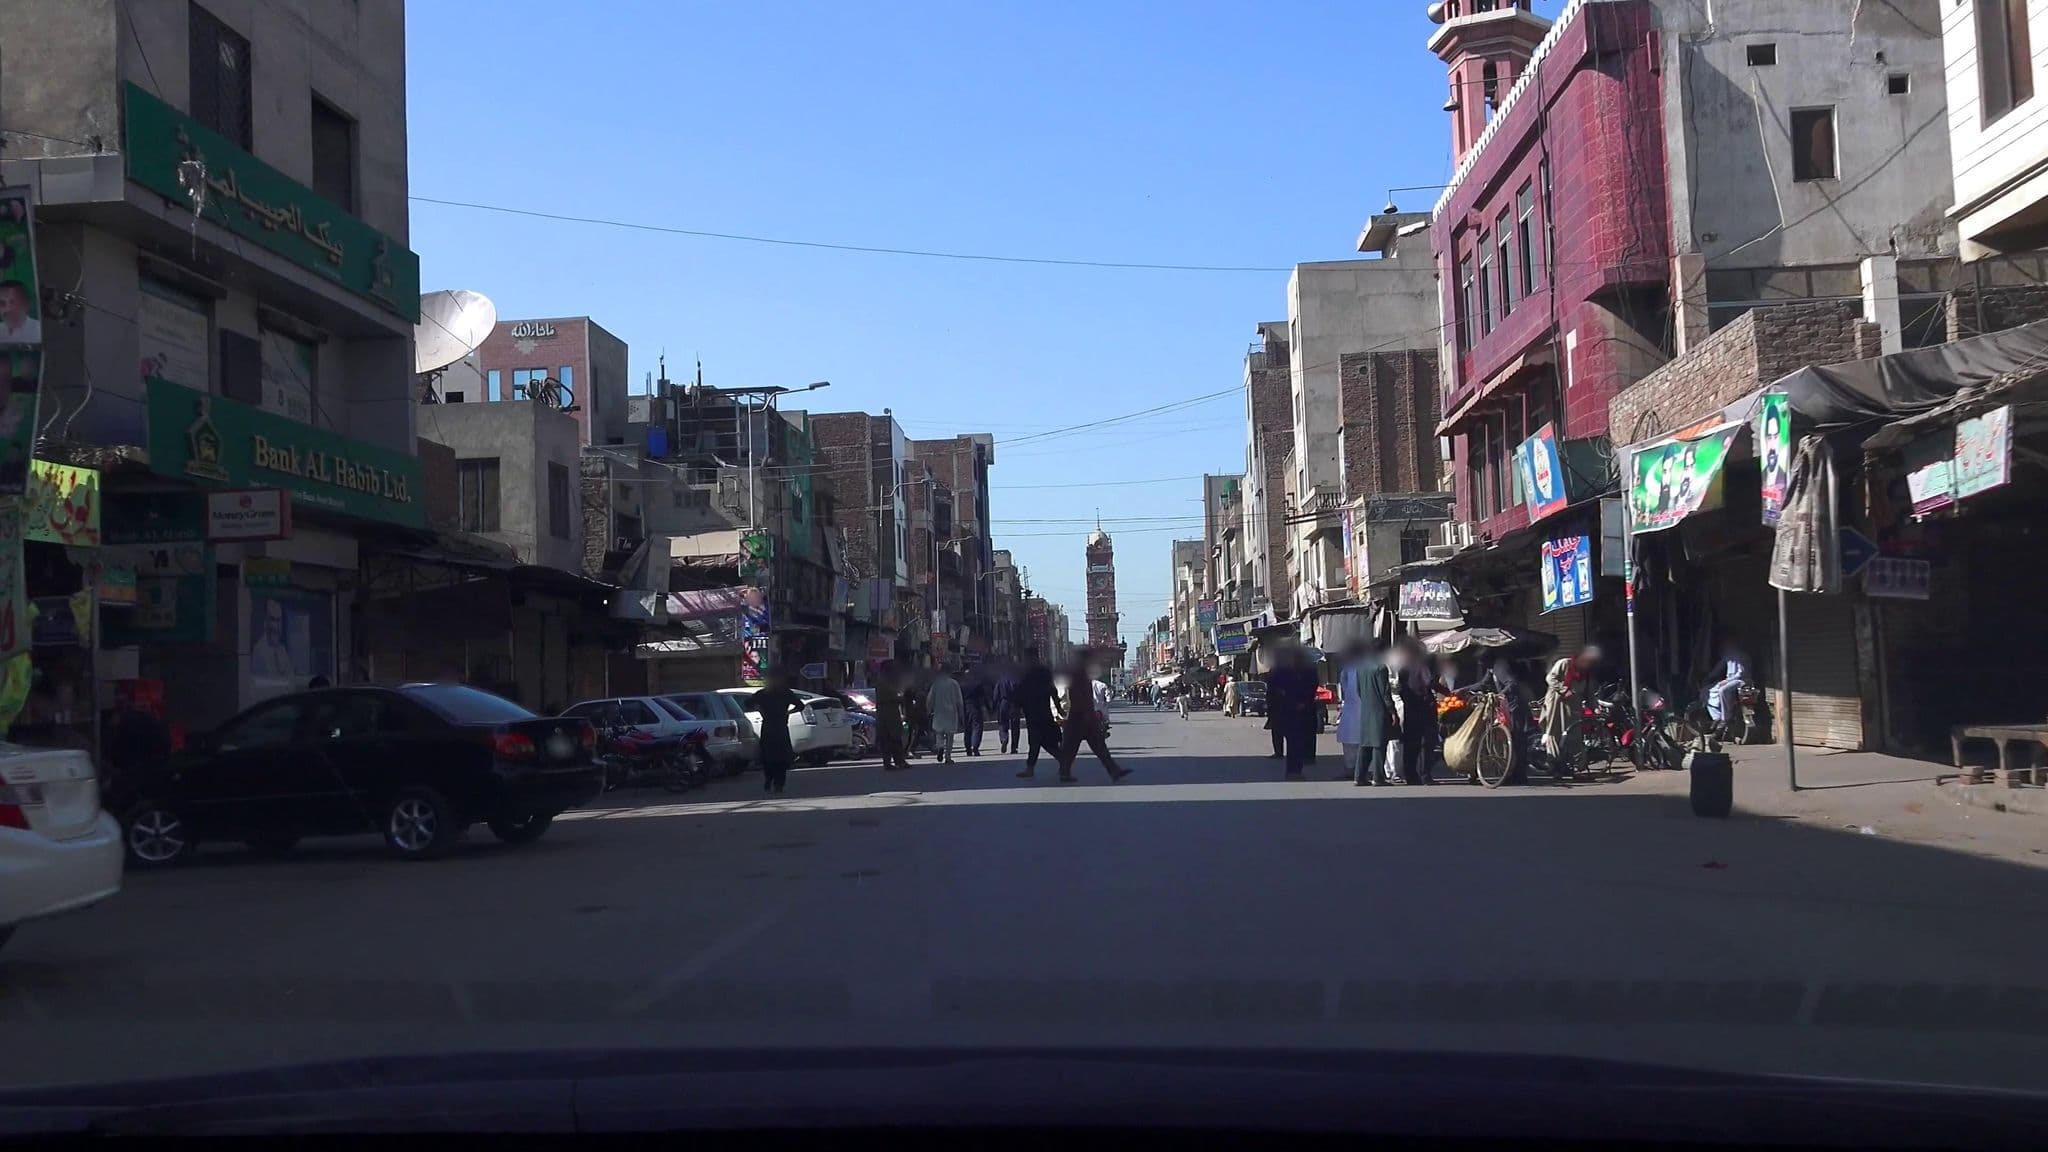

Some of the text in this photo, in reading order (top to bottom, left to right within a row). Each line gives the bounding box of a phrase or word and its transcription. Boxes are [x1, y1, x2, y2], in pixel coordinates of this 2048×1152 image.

[253, 434, 302, 477] Bank
[304, 450, 332, 483] AL
[334, 456, 381, 495] Habib
[382, 469, 412, 503] Ltd.
